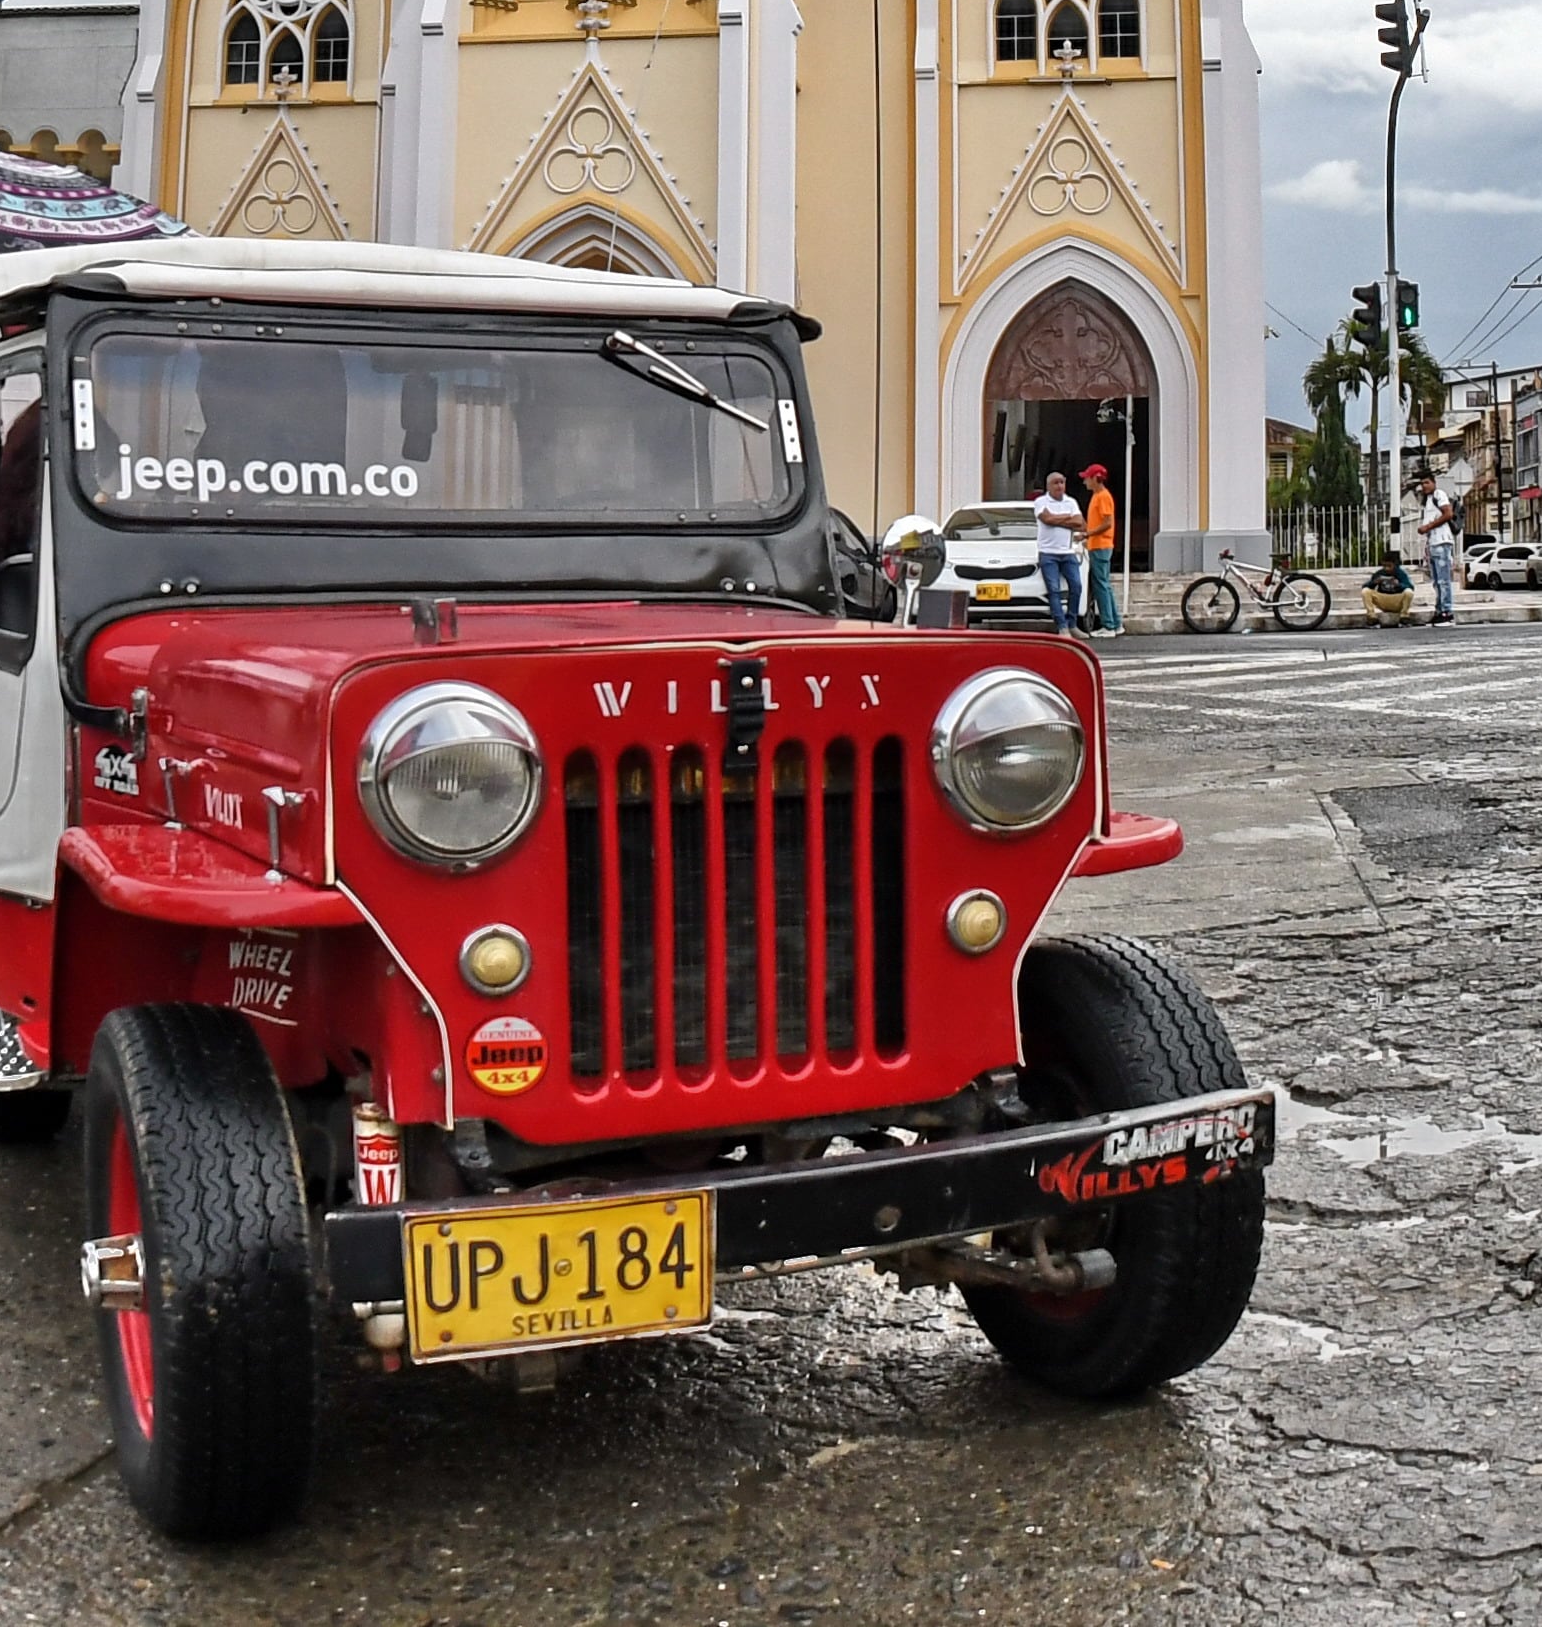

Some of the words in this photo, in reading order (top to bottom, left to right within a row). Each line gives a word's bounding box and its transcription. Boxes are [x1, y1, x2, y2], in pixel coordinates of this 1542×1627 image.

[116, 443, 418, 502] jeep.com.co
[229, 941, 293, 977] WHEEL
[231, 977, 294, 1010] DRIVE
[479, 1031, 535, 1041] GENUINE
[471, 1045, 544, 1066] Jeep
[1102, 1104, 1257, 1166] CAMPERO
[359, 1145, 399, 1163] Jeep
[422, 1233, 550, 1313] UPJ
[577, 1221, 695, 1301] 184
[511, 1305, 614, 1336] SEVILLA
